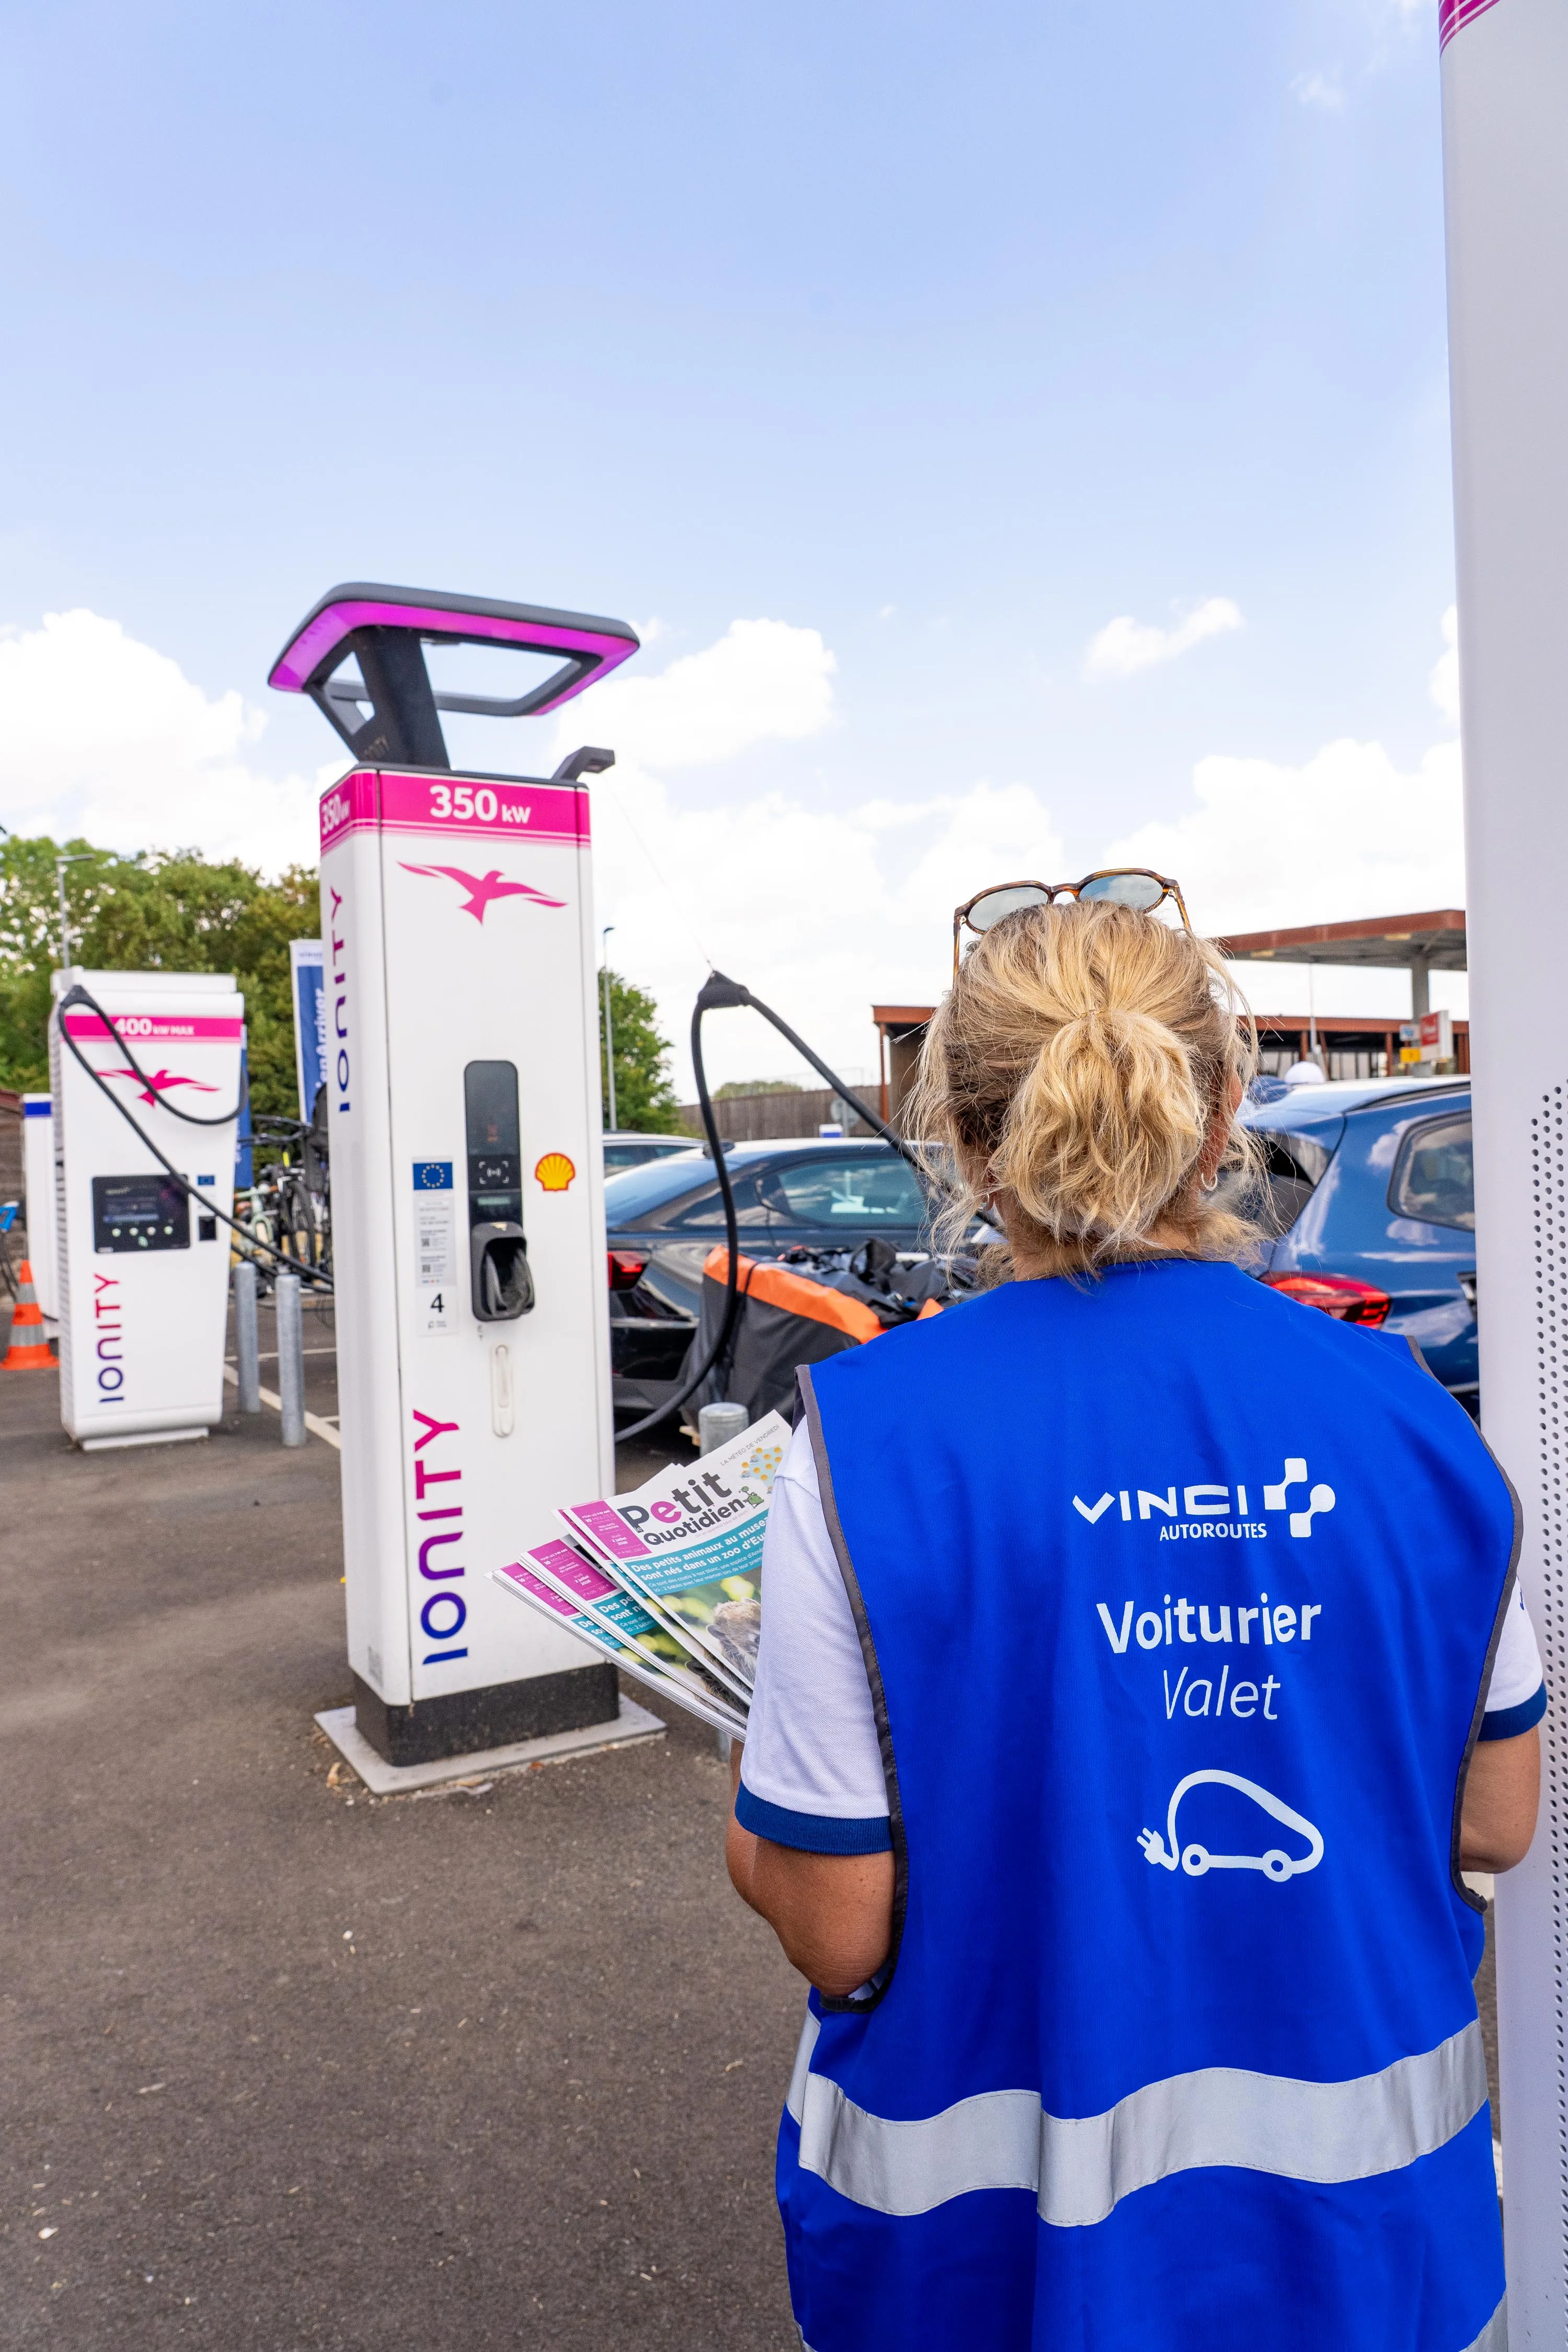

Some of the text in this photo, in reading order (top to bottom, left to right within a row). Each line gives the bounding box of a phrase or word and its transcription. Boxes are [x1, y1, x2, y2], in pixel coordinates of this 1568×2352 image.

[429, 785, 532, 824] 350 kW
[330, 886, 351, 1113] IONITY
[114, 1018, 153, 1035] 400
[170, 1025, 195, 1036] MAX
[430, 1293, 445, 1313] 4
[94, 1274, 124, 1403] IONITY
[754, 1425, 780, 1444] VENDREDI
[617, 1472, 732, 1532] Petit
[643, 1498, 745, 1545] Quotidien
[1072, 1485, 1248, 1525] VINCI
[412, 1409, 468, 1666] IONITY
[1159, 1523, 1267, 1541] AUTOROUTES
[631, 1562, 652, 1572] Des
[653, 1555, 682, 1569] petits
[683, 1542, 724, 1560] animaux
[724, 1536, 739, 1545] au
[640, 1570, 664, 1581] sont
[664, 1564, 682, 1576] nés
[684, 1560, 707, 1572] dans
[707, 1555, 721, 1564] un
[721, 1548, 741, 1559] zoo
[598, 1602, 620, 1612] Des
[610, 1609, 633, 1620] sont
[1096, 1592, 1322, 1654] Voiturier
[1163, 1665, 1281, 1720] Valet
